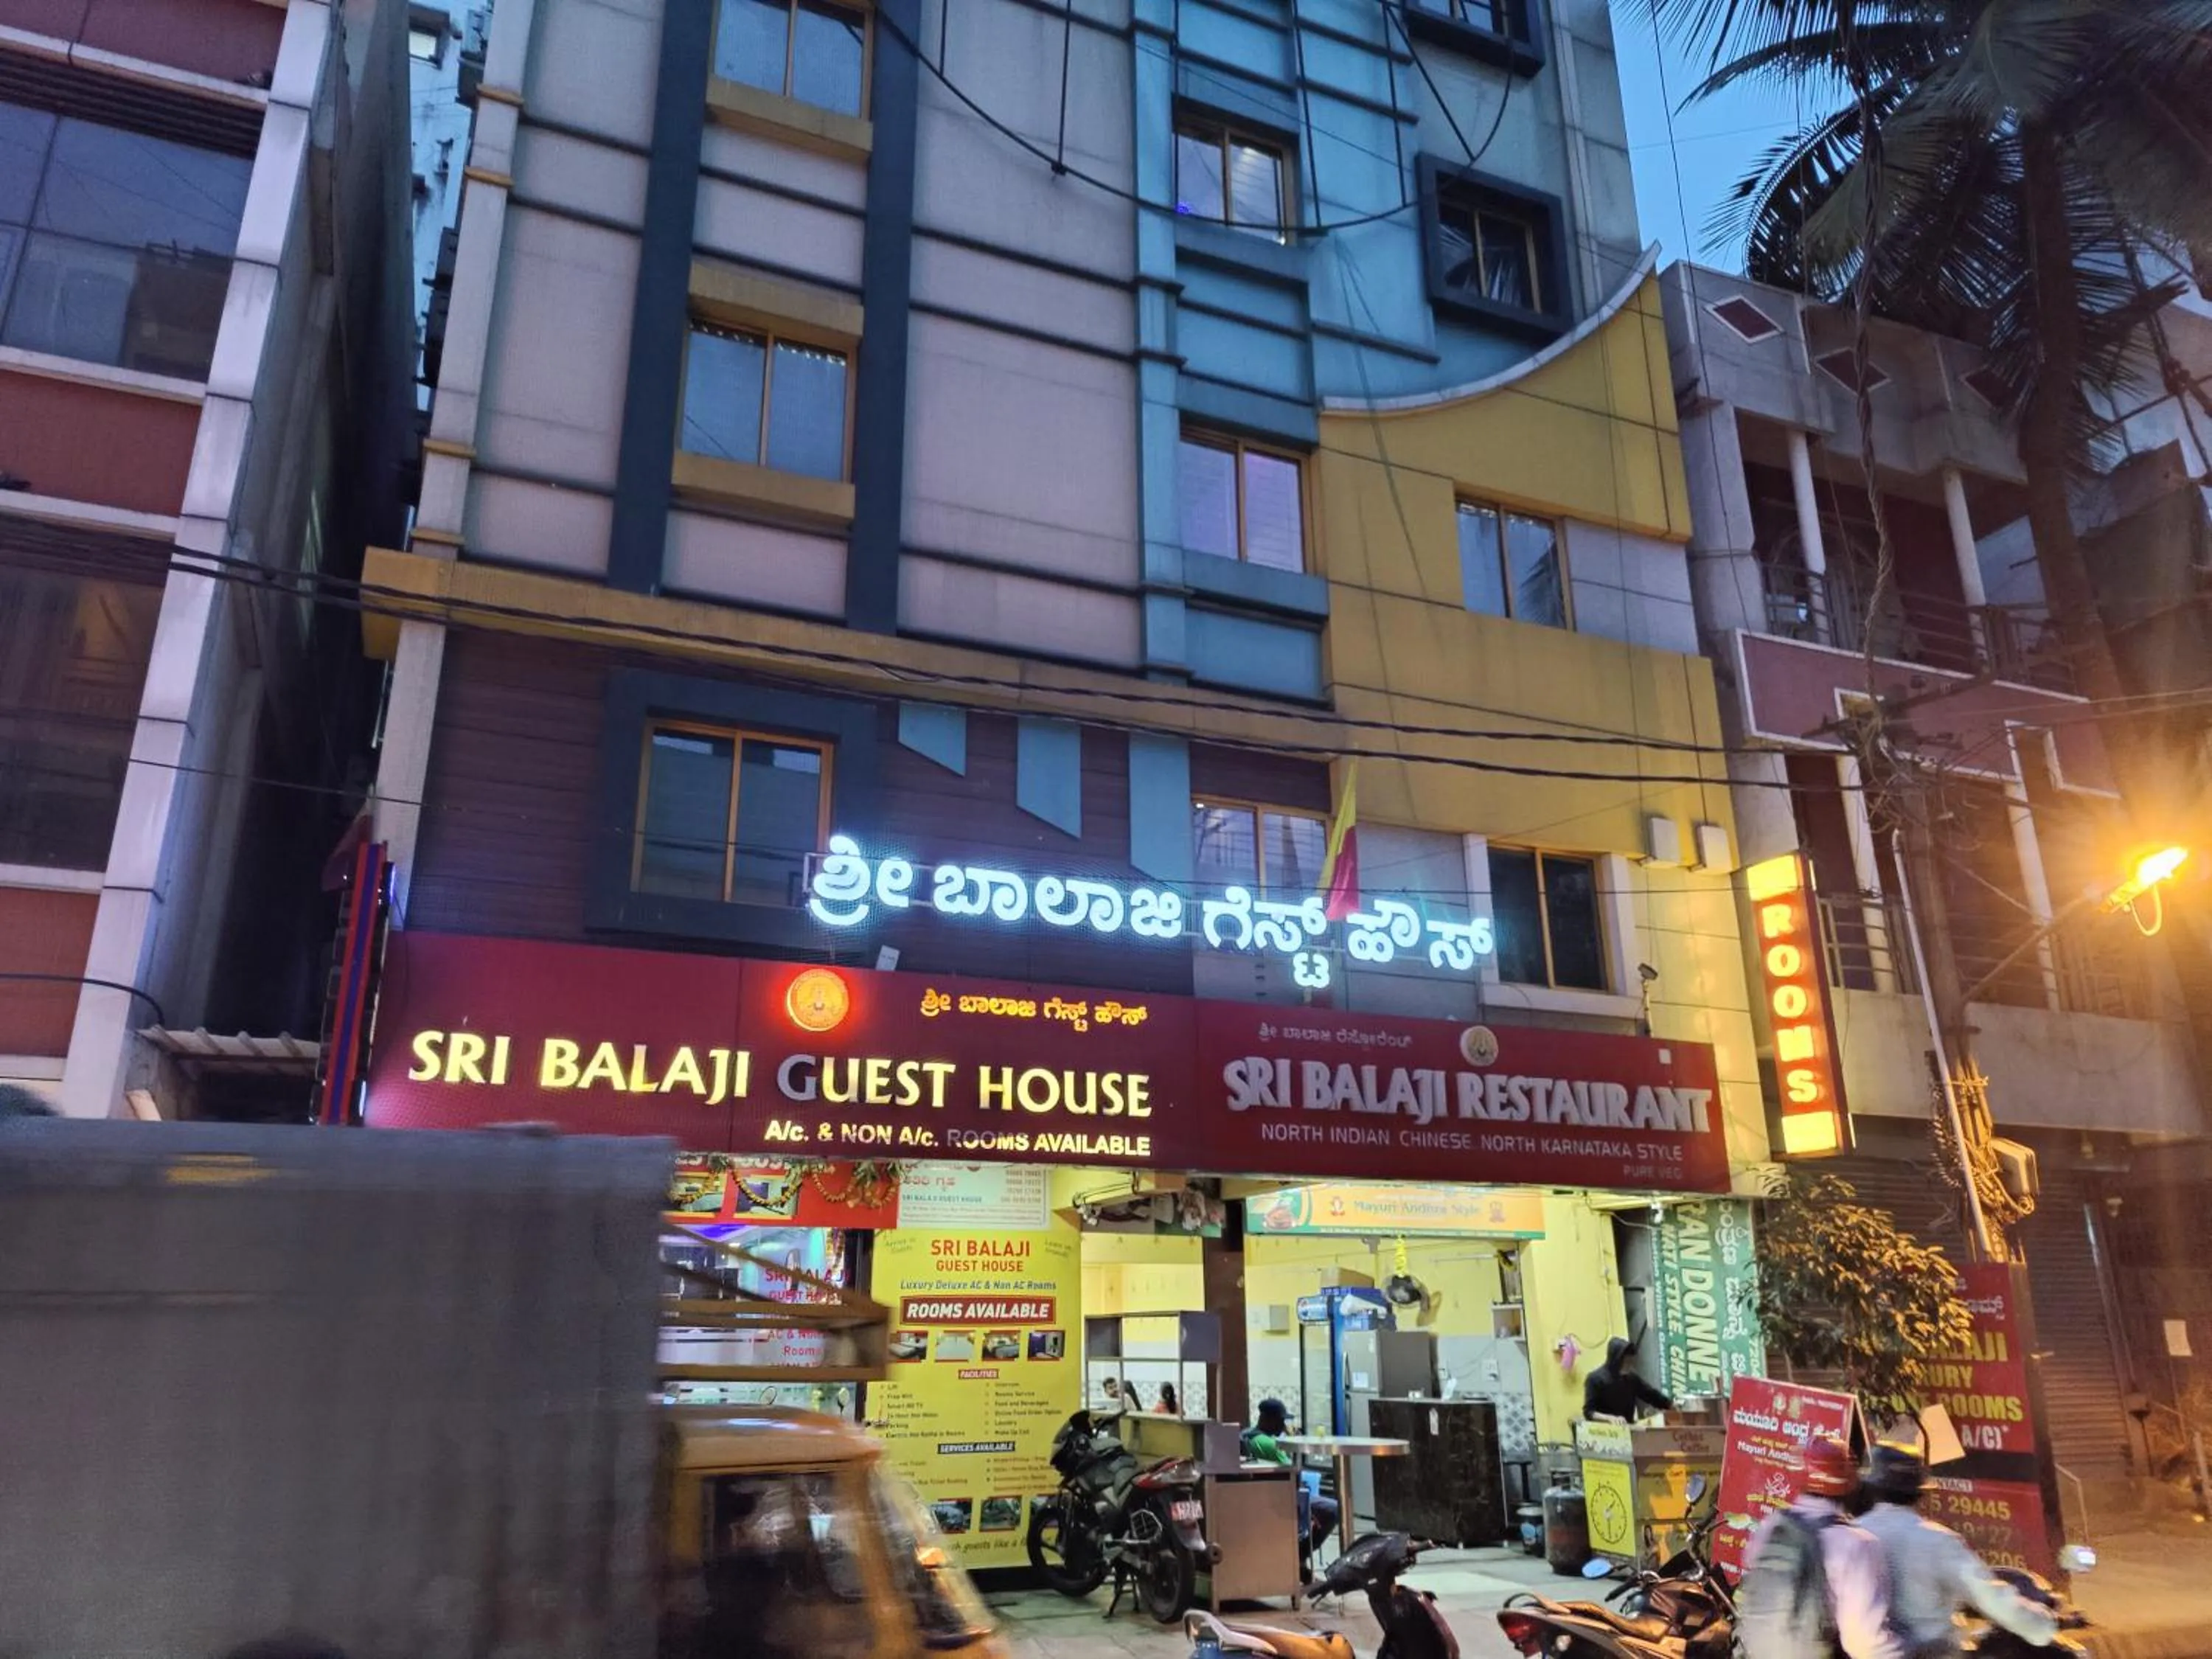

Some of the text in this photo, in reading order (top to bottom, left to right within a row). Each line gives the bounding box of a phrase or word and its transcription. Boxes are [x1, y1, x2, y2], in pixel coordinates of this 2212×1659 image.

[810, 835, 1493, 989] ಶ್ರೀ ಬಾಲಾಜಿ ಗೆಸ್ಟ್ ಹೌಸ್
[920, 988, 1147, 1032] ಶ್ರೀ ಬಾಲಾಜಿ ಗೆಸ್ಟ್ ಹೌಸ್
[1761, 903, 1818, 1103] ROOMS
[1259, 1022, 1277, 1042] ಶ್ರೀ
[408, 1030, 1153, 1118] SRI BALAJI GUEST HOUSE
[1223, 1057, 1712, 1133] SRI BALAJI RESTAURANT
[817, 1122, 833, 1142] &
[841, 1123, 891, 1145] NON
[947, 1128, 1029, 1151] ROOMS
[1034, 1133, 1152, 1157] AVAILABLE
[1262, 1123, 1683, 1161] NORTH INDIAN CHINESE NORTH KARNATAKA STYLE
[1623, 1164, 1655, 1180] PURE
[931, 1239, 960, 1256] SRI
[967, 1239, 1031, 1257] BALAJI
[936, 1260, 1024, 1272] GUEST HOUSE
[900, 1279, 933, 1292] Luxury
[935, 1280, 967, 1290] Deluxe
[1026, 1280, 1057, 1290] Rooms
[1676, 1202, 1721, 1383] RAN DONNE
[907, 1303, 1050, 1318] ROOMS AVAILABLE
[1947, 1495, 2011, 1520] 29445
